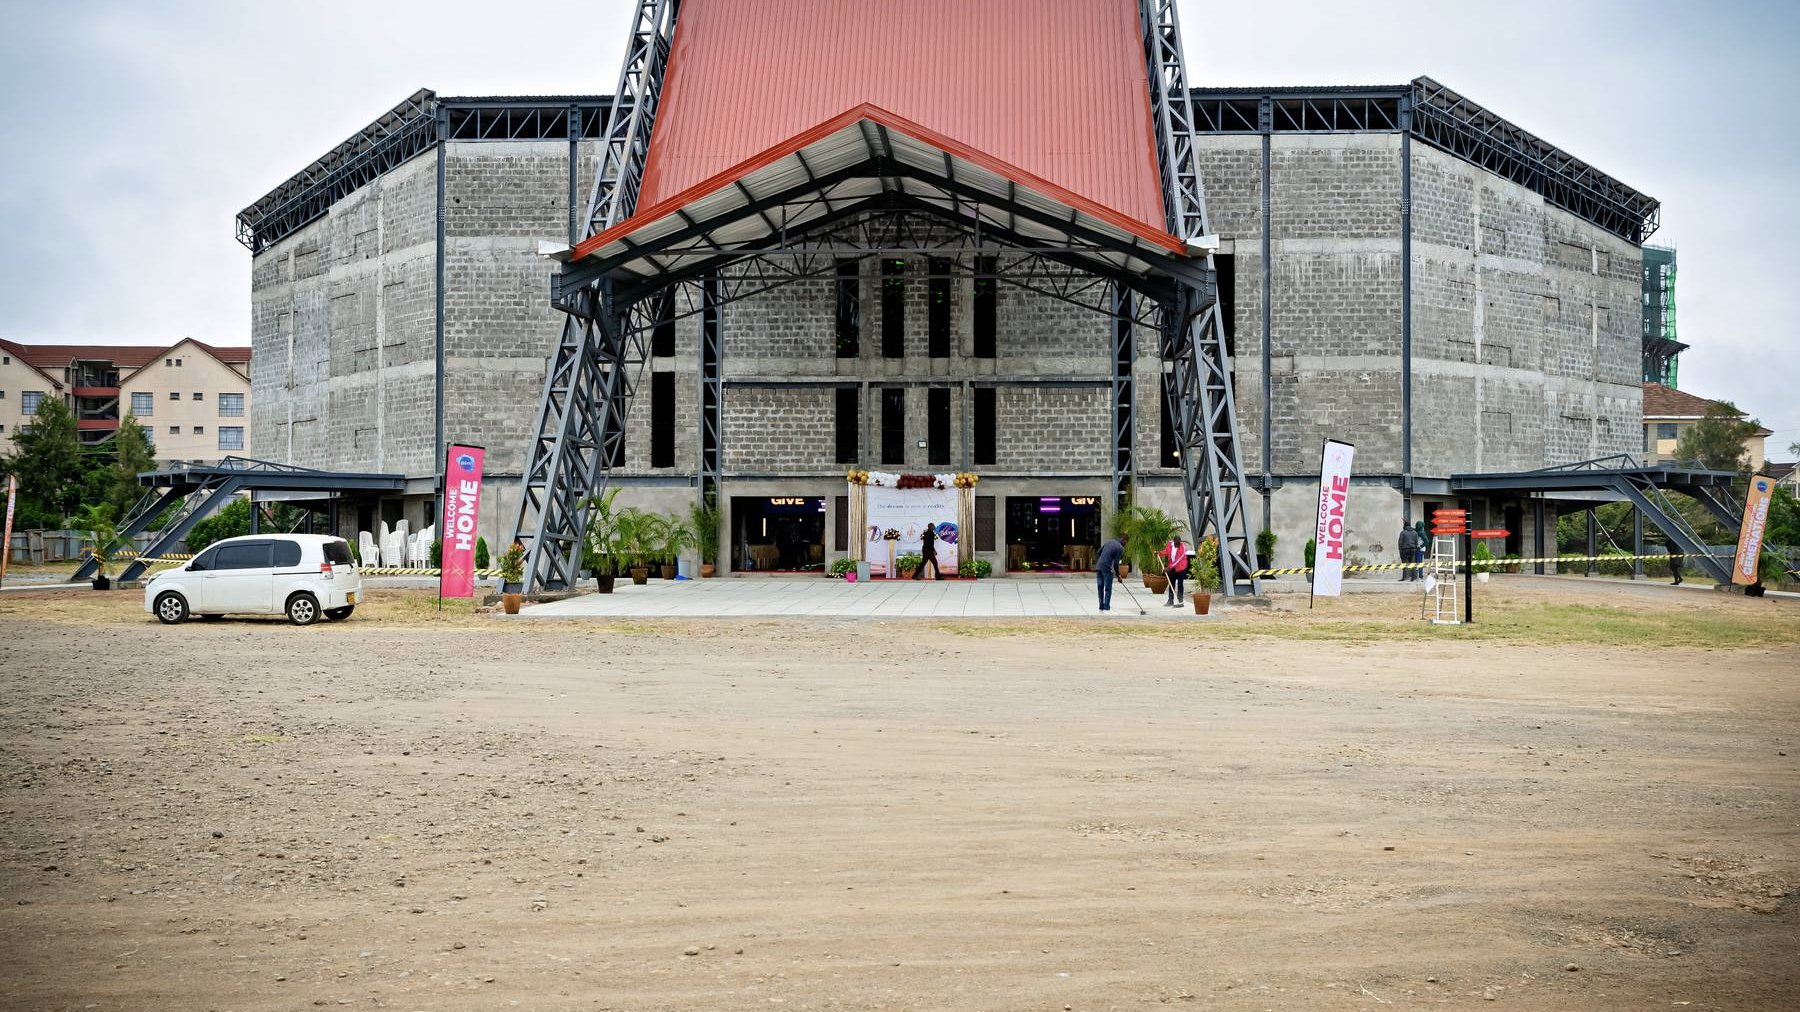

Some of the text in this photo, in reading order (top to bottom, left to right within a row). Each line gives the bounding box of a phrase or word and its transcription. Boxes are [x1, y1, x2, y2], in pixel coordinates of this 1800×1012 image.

[445, 488, 457, 538] WELCOME
[455, 479, 478, 550] HOME
[1318, 486, 1329, 545] WELCOME
[1326, 475, 1348, 560] HOME
[1743, 496, 1769, 576] GENERATIONS
